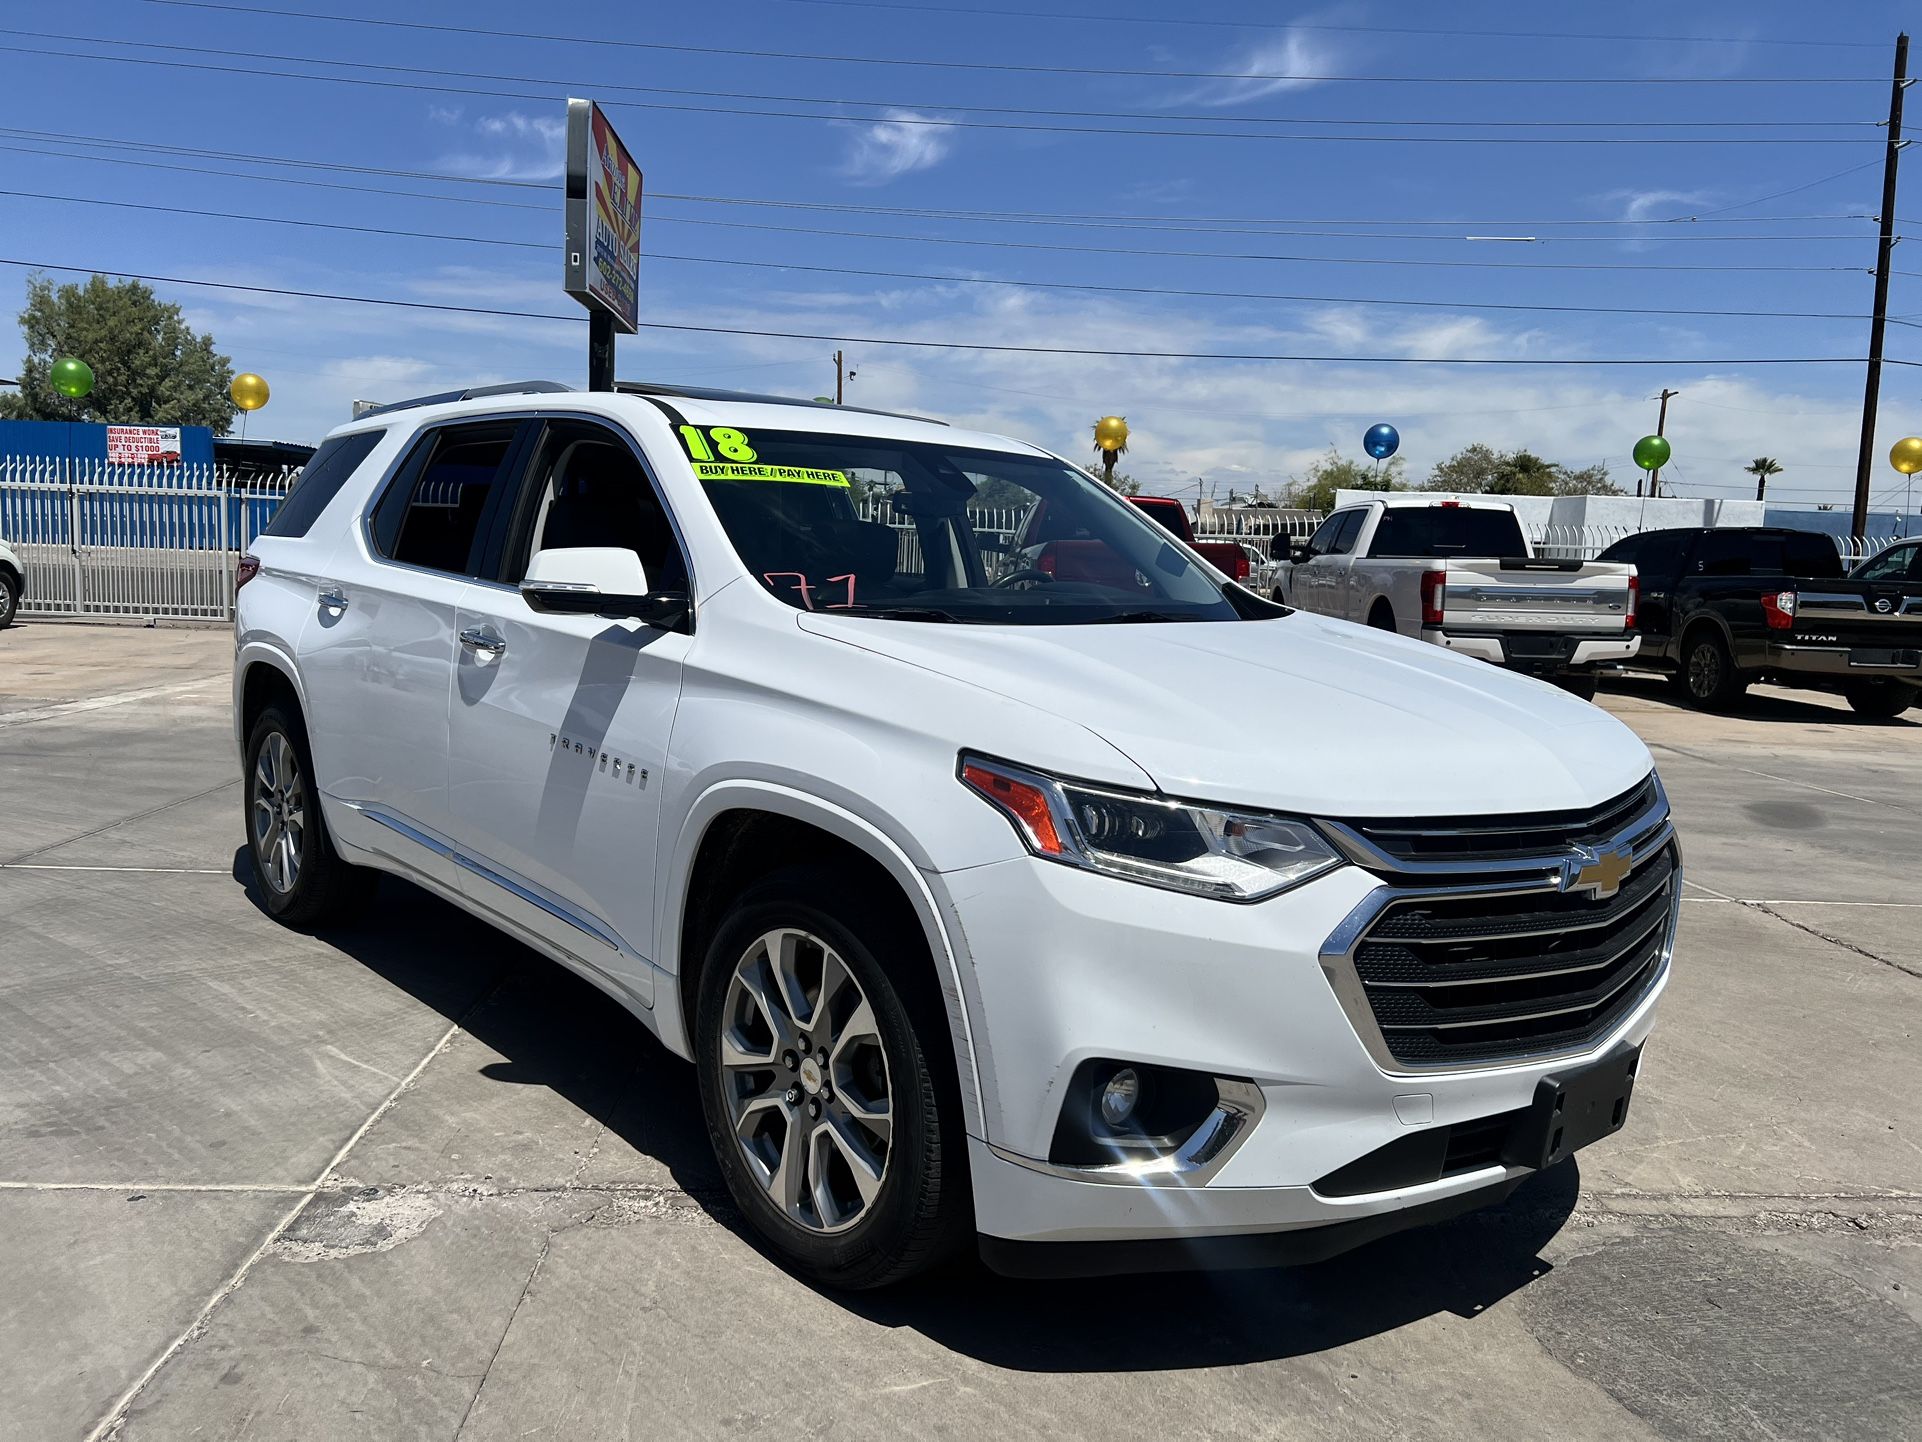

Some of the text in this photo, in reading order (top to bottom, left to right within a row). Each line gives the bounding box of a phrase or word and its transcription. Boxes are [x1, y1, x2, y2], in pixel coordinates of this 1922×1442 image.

[596, 216, 618, 257] AUTO
[619, 240, 637, 280] SALES
[124, 436, 160, 444] DEDUCTIBLE
[679, 424, 758, 463] 18
[122, 444, 132, 452] TO
[700, 465, 728, 476] BUY
[730, 466, 767, 477] HERE
[779, 469, 803, 480] PAY
[806, 470, 841, 482] HERE
[1471, 615, 1600, 625] SUPER DUTY
